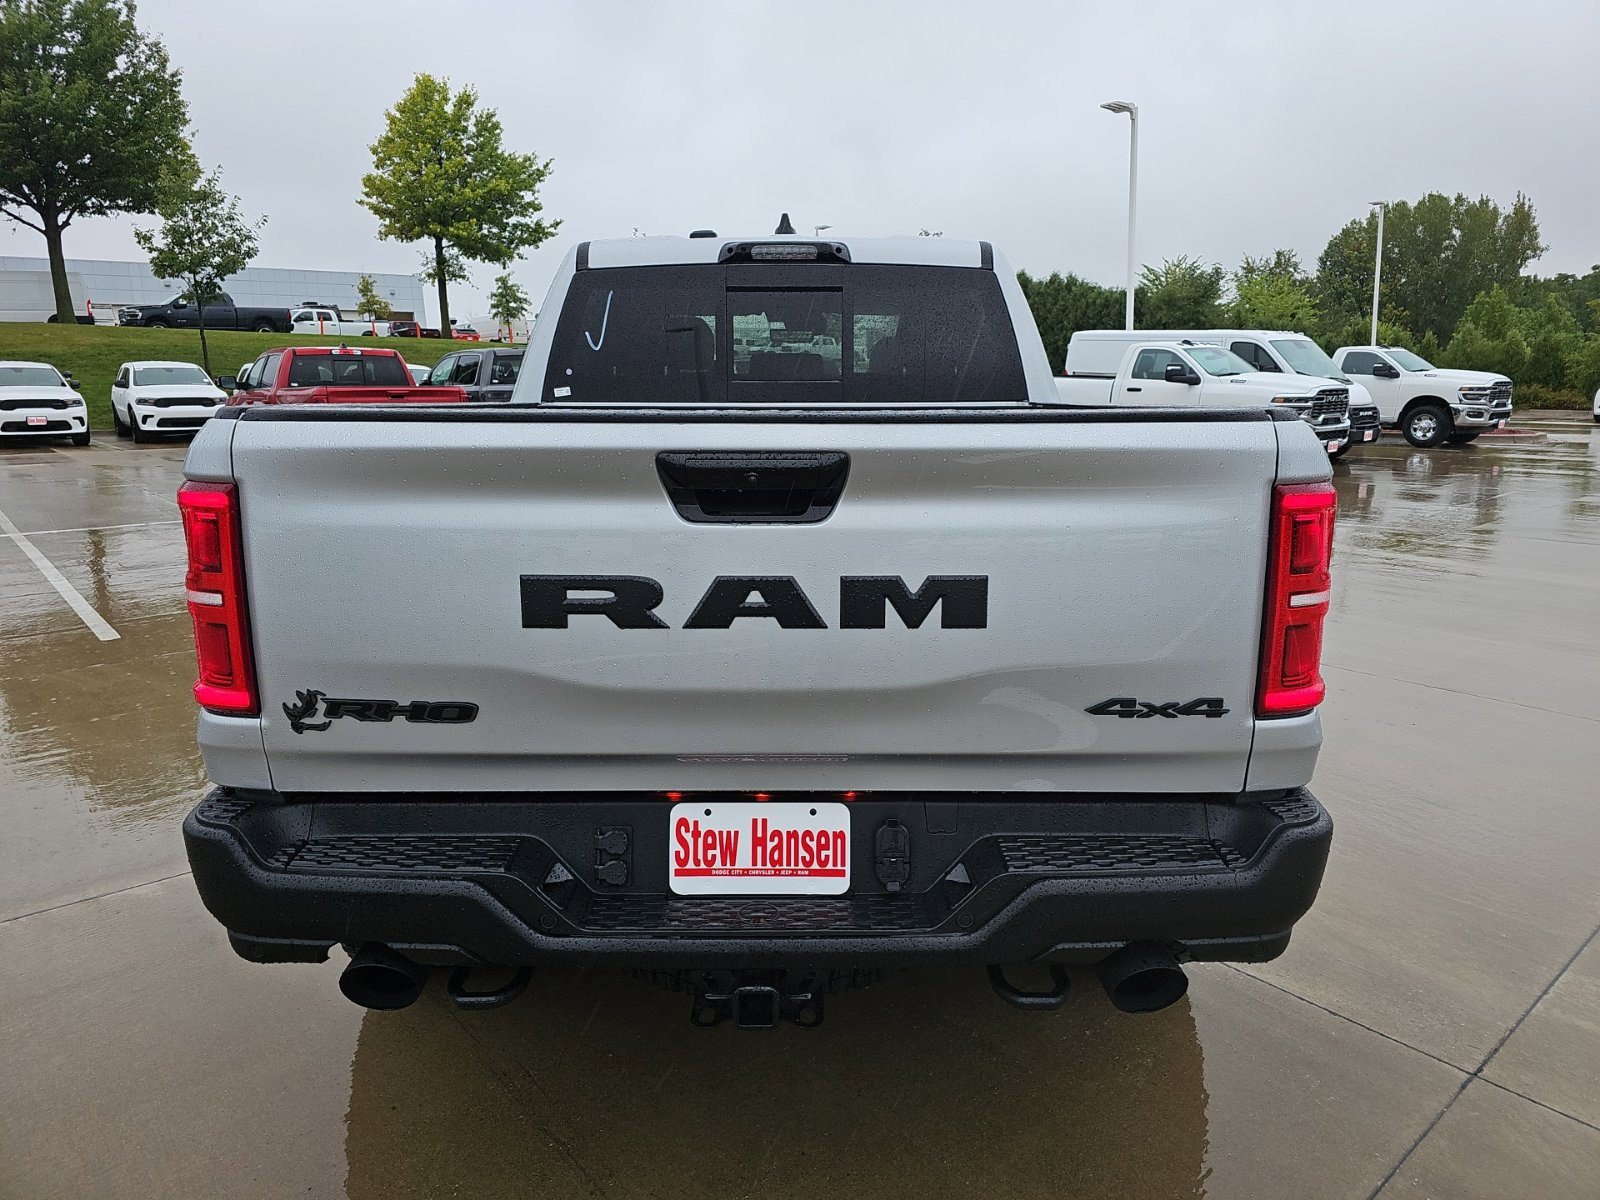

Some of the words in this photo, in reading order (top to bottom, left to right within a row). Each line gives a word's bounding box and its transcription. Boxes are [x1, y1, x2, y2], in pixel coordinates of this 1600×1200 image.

[519, 574, 989, 629] RAM
[320, 697, 480, 724] RHO
[1084, 697, 1231, 718] 4x4
[674, 816, 739, 868] Stew
[751, 817, 846, 868] Hansen
